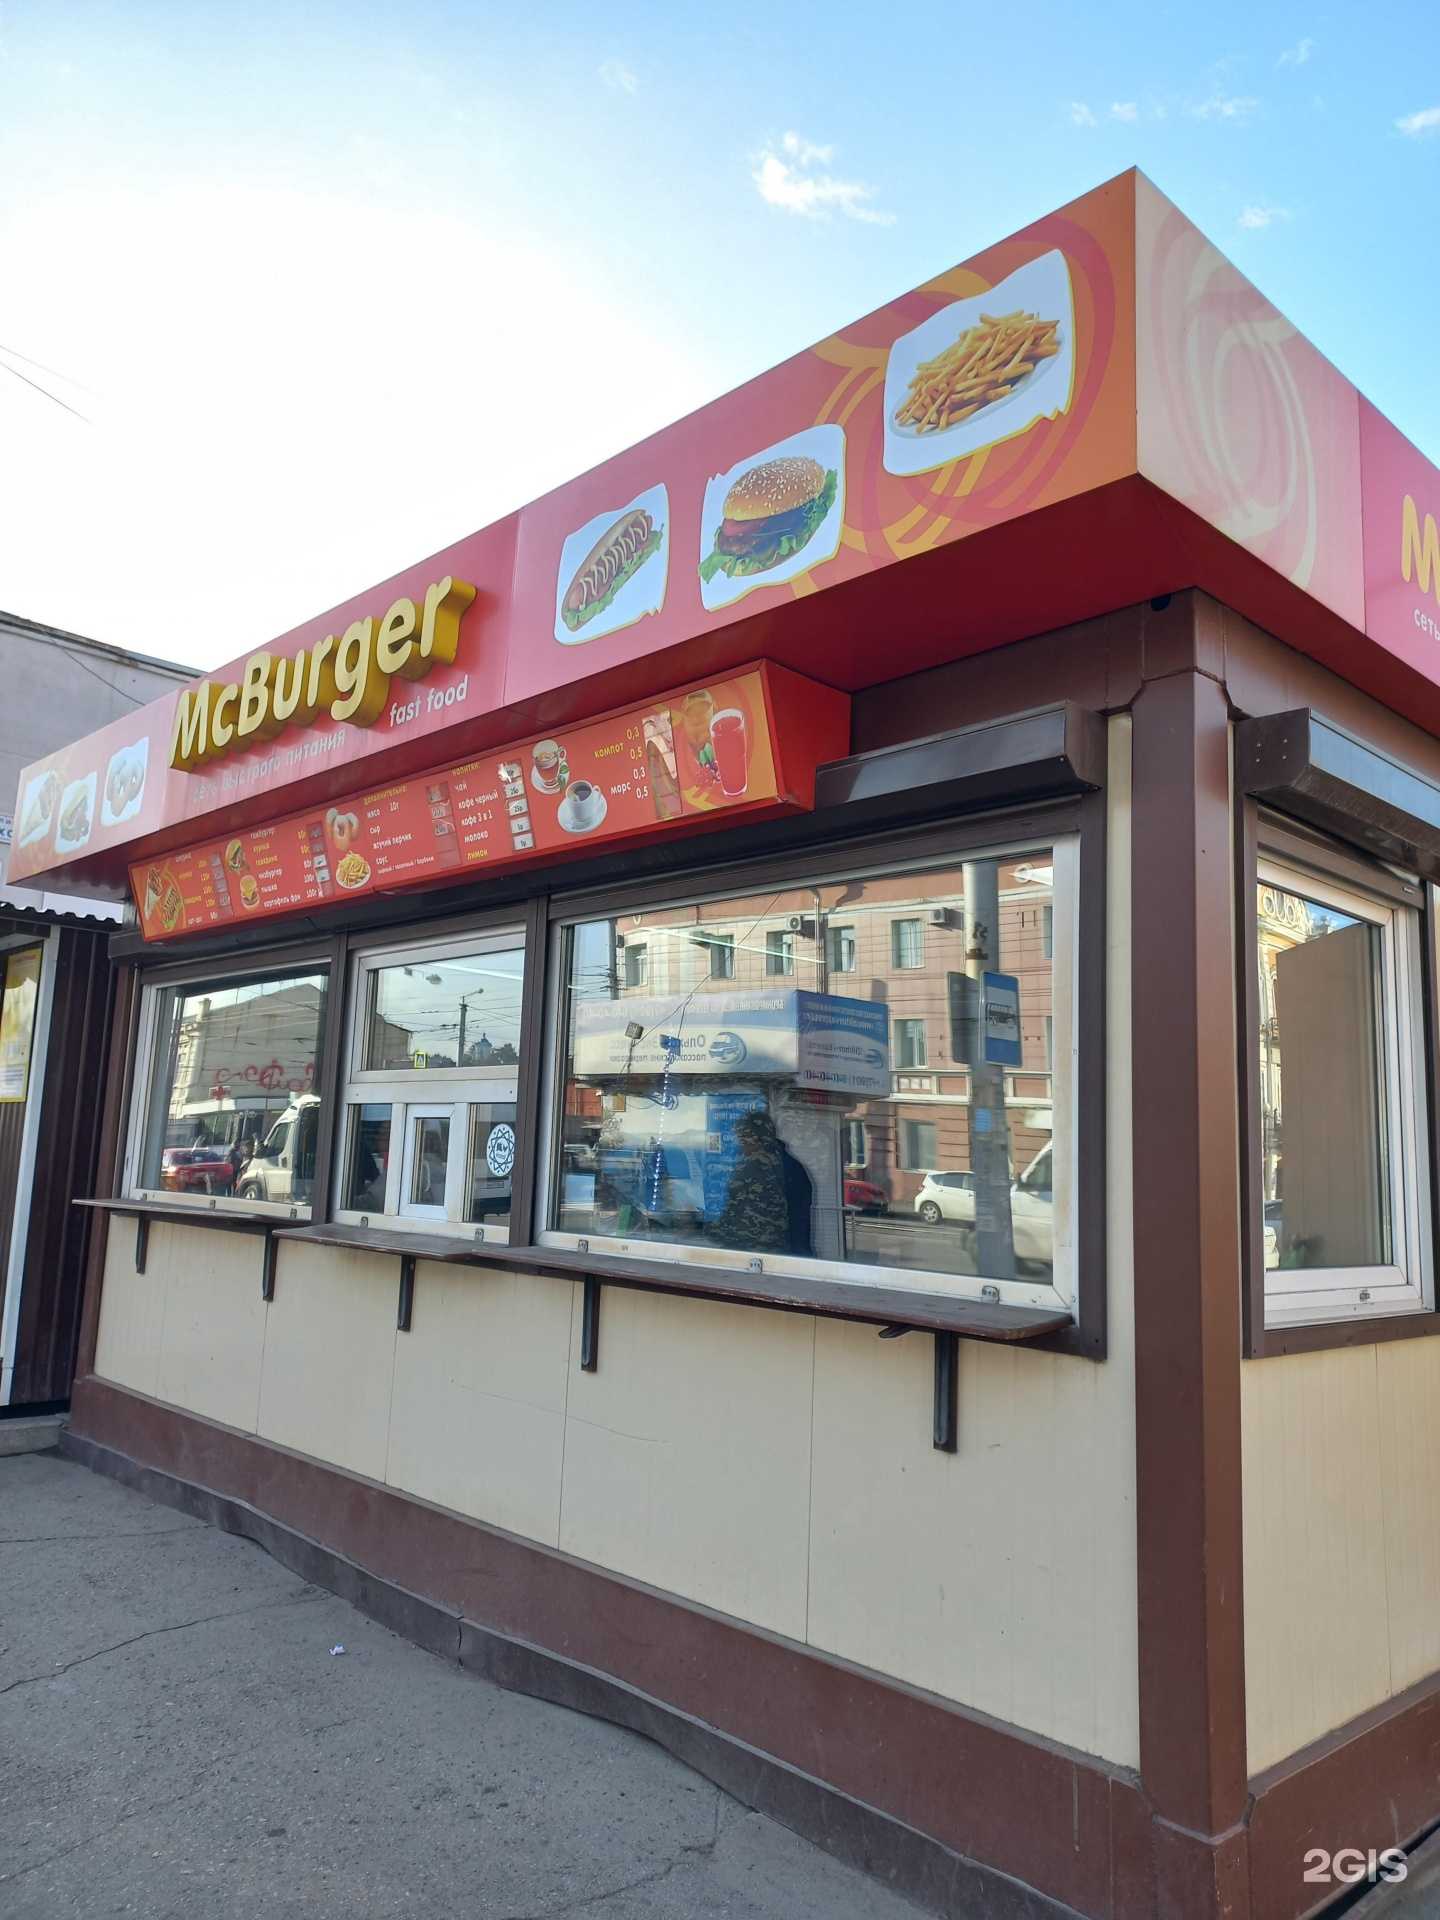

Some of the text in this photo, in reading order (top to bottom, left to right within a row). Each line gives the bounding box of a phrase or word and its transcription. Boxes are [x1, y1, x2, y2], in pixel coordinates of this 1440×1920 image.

[169, 574, 462, 770] McBurger
[390, 674, 468, 727] fast food
[287, 729, 346, 768] питания
[594, 726, 640, 758] компот 0,3
[630, 746, 642, 760] 0,5
[610, 766, 646, 795] морс 0,3
[458, 789, 499, 810] кофе черный
[636, 786, 649, 799] 0,5
[462, 814, 477, 826] кофе
[369, 825, 381, 836] сыр
[464, 830, 489, 843] молоко
[376, 855, 388, 865] соус
[467, 849, 488, 861] лимон
